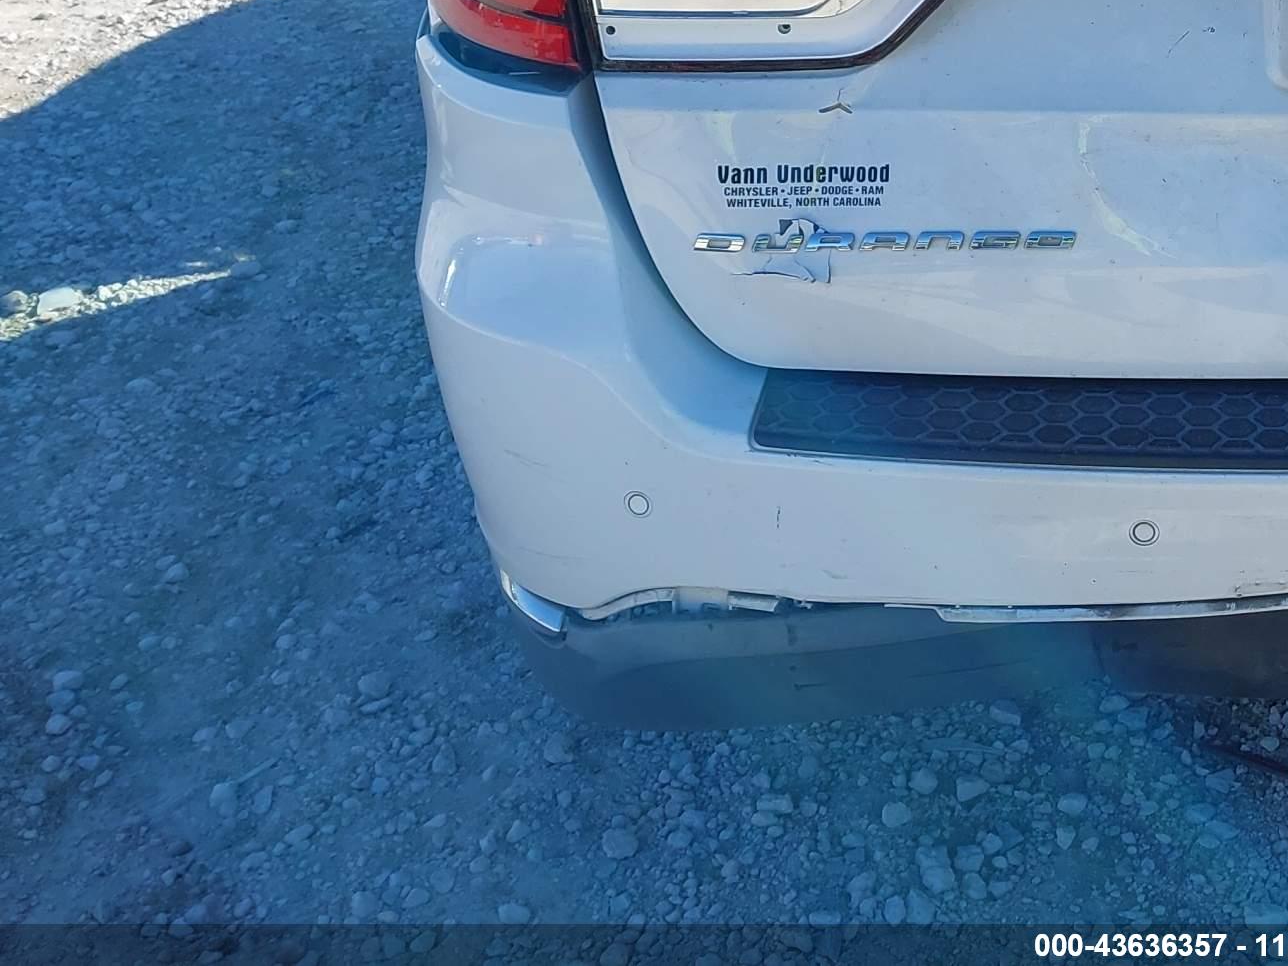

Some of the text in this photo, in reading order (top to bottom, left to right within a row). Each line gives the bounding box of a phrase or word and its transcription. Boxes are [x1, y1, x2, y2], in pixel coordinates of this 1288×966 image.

[717, 163, 890, 184] Vann Underwood
[724, 185, 884, 196] CHRYSLER JEEP DODGE RAM
[726, 196, 882, 209] WHITEVILLE, NORTH CAROLINA
[692, 229, 1078, 254] DURANGO
